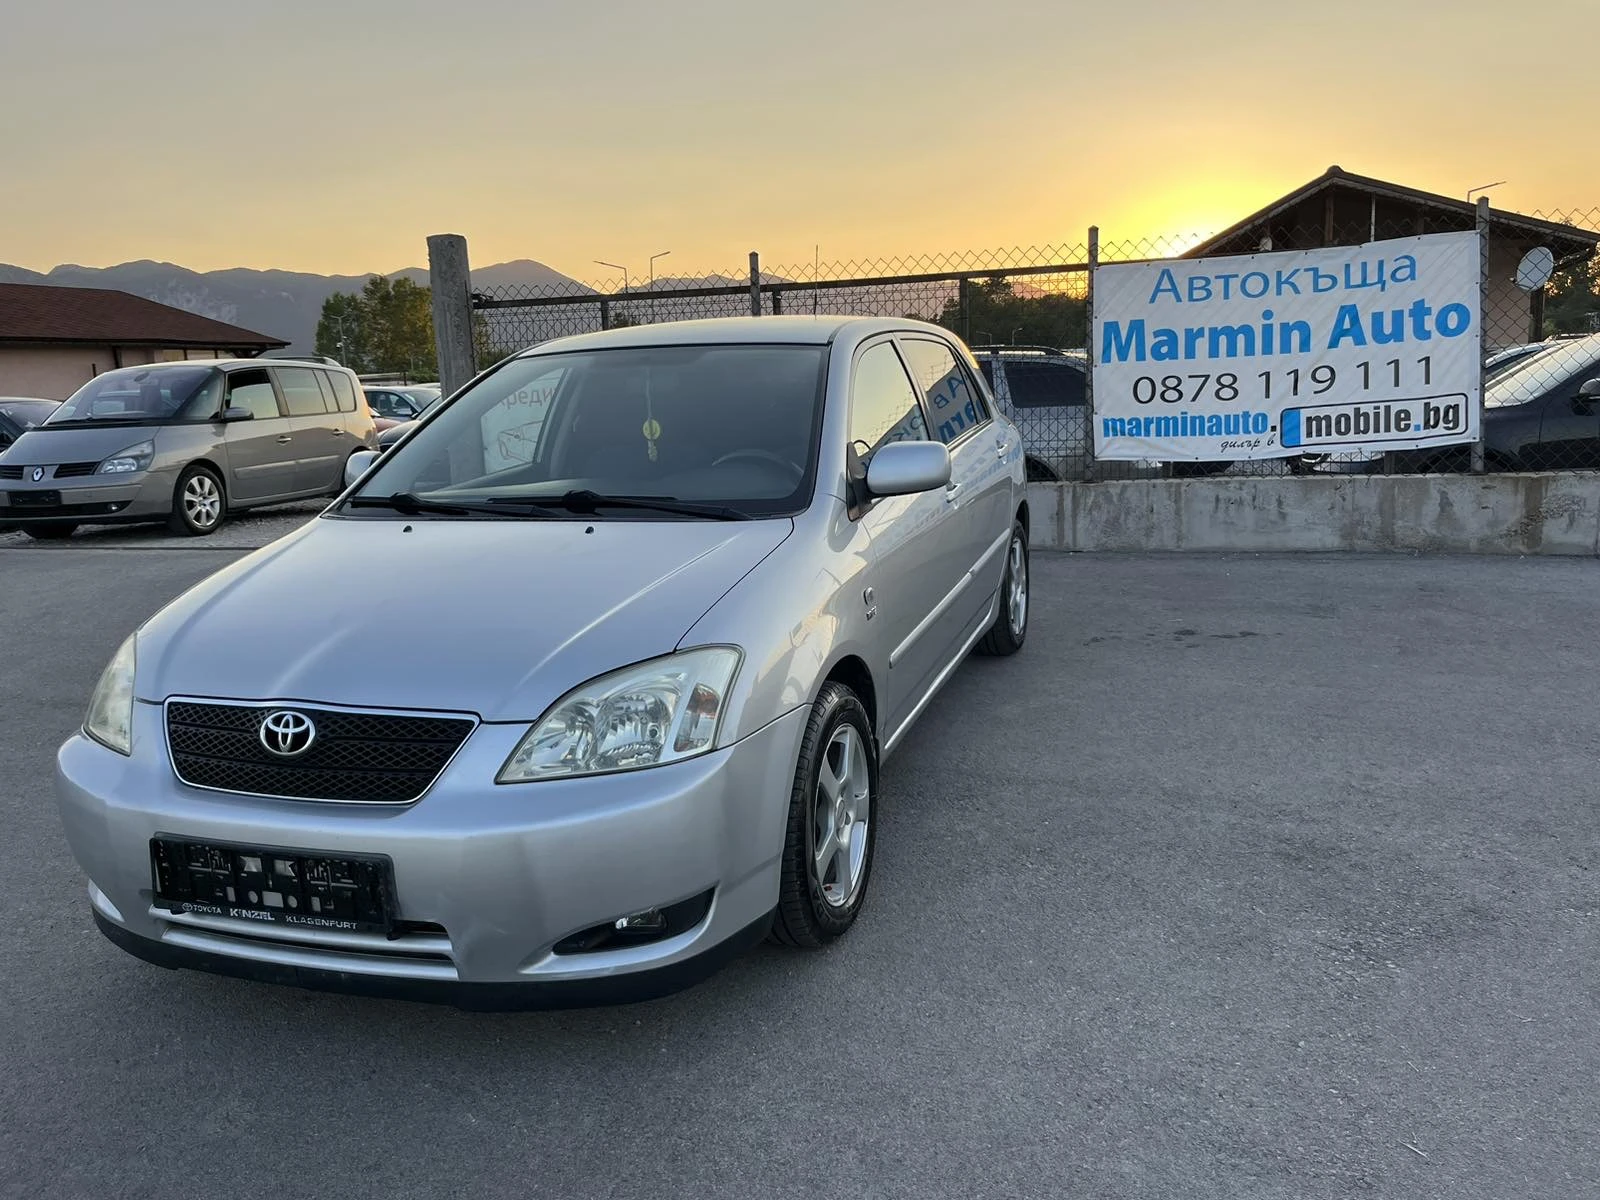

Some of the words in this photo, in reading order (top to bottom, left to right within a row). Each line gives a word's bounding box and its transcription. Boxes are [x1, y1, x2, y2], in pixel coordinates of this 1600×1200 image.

[1148, 254, 1417, 304] Автокъща
[1101, 309, 1312, 364] Marmin
[1326, 298, 1471, 350] Auto
[1132, 372, 1240, 404] 0878
[1258, 364, 1337, 399] 119
[1357, 355, 1432, 390] 111
[1305, 401, 1460, 438] mobile.bg
[193, 904, 222, 914] TOYOTA
[284, 914, 358, 930] KLAGENFURT
